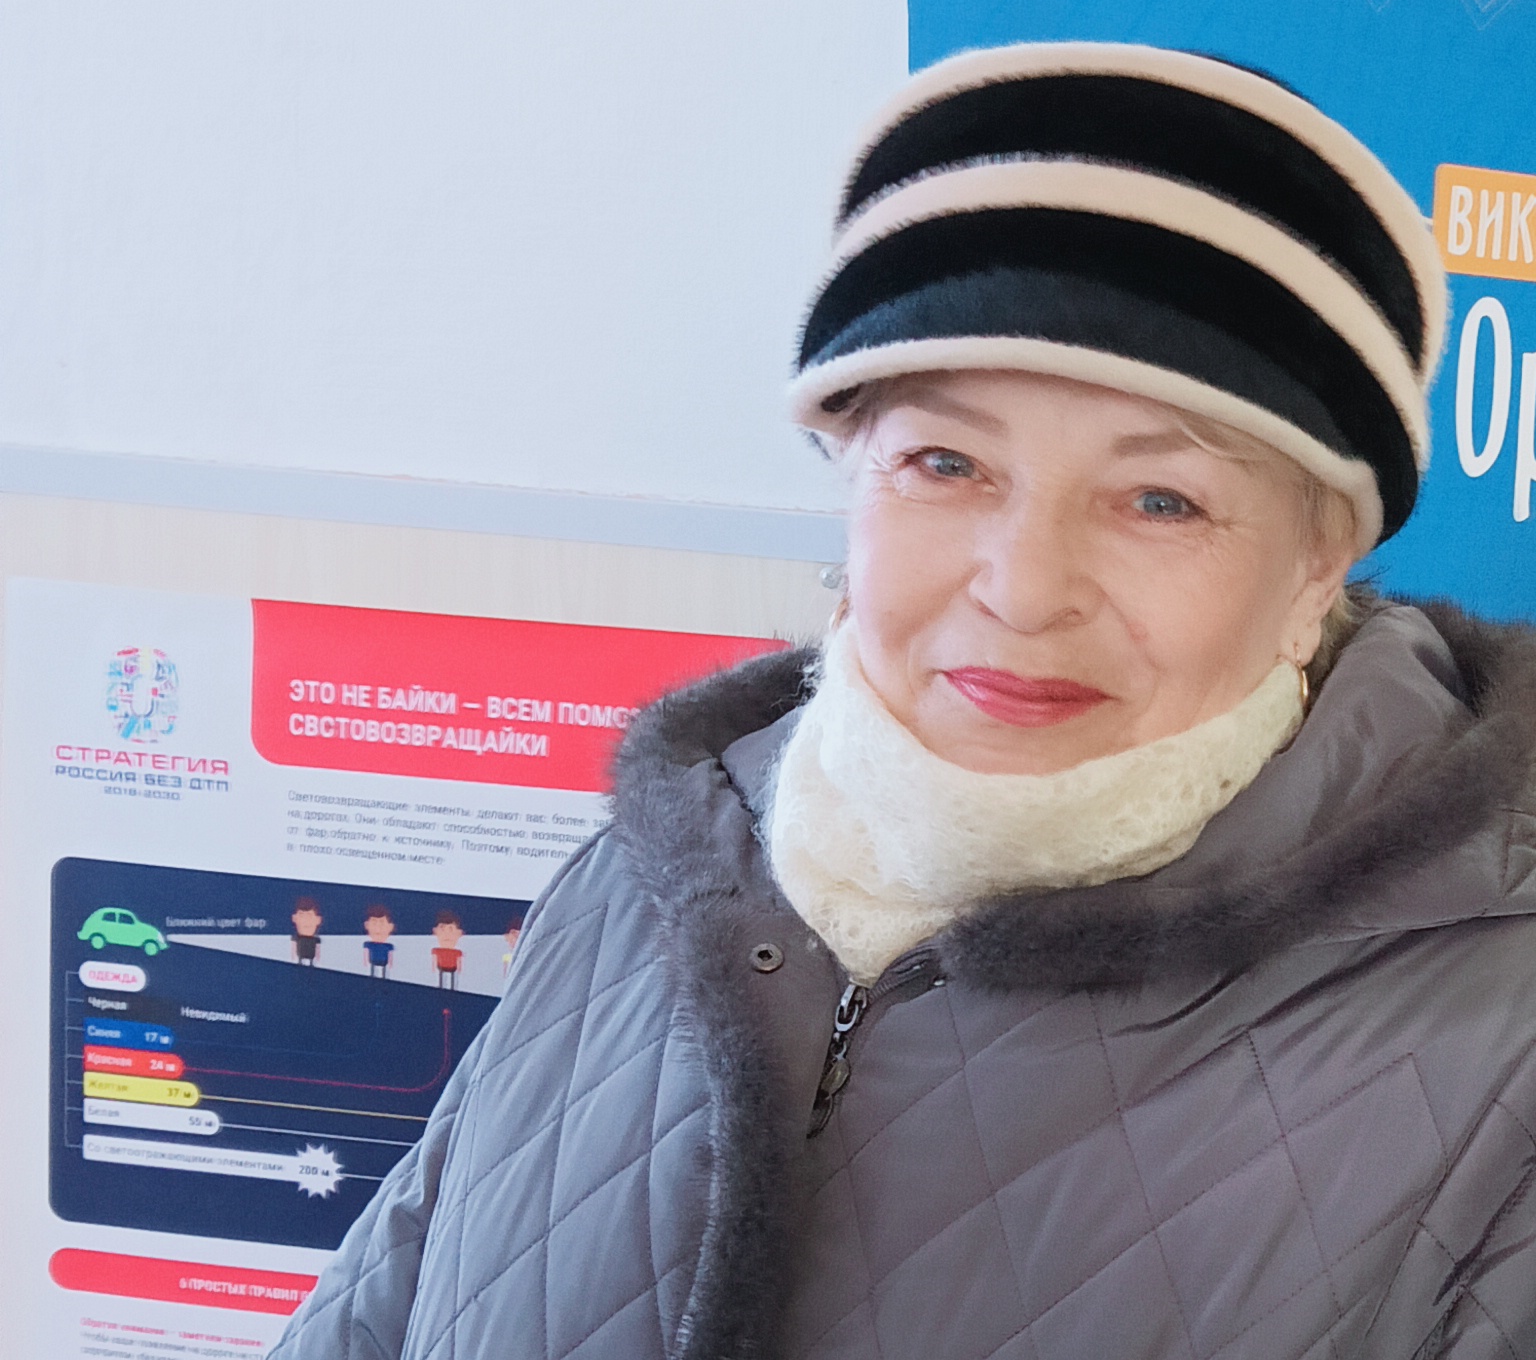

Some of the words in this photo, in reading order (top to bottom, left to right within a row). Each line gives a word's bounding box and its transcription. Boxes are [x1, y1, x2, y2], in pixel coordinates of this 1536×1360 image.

[289, 679, 336, 705] ЭТО
[342, 684, 370, 708] НЕ
[377, 684, 457, 715] БАЙКИ
[487, 696, 551, 723] ВСЕМ
[55, 744, 229, 776] СТРАТЕГИЯ
[54, 765, 137, 783] РОССИЯ
[144, 773, 183, 789] БЕЗ
[189, 777, 229, 792] ДТП
[144, 1031, 158, 1042] 17
